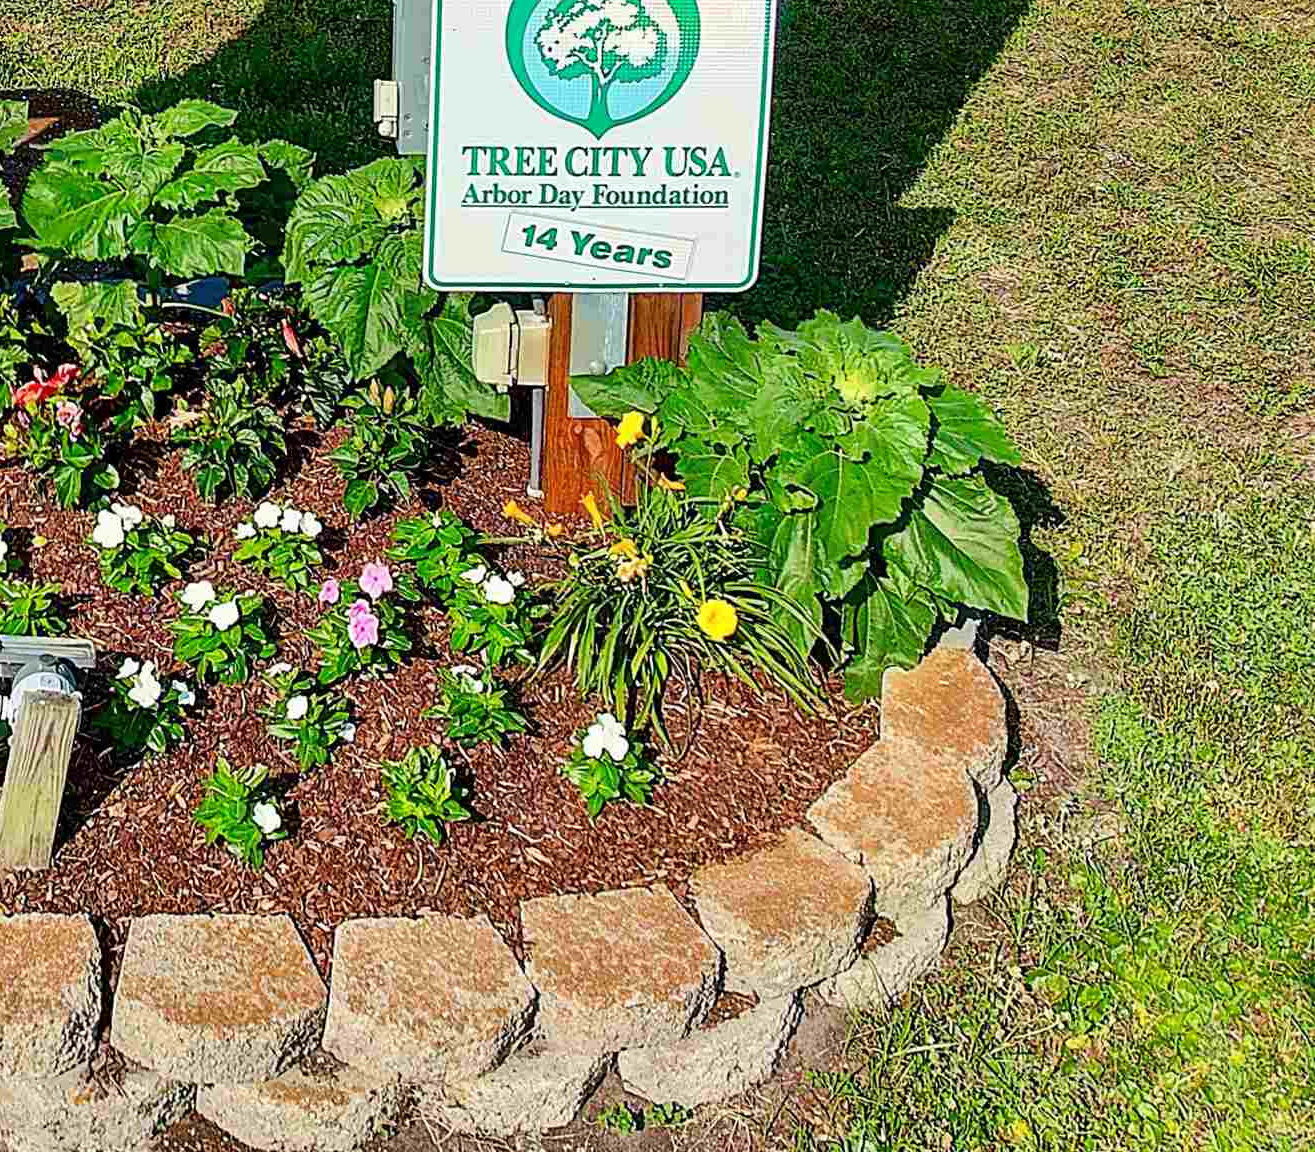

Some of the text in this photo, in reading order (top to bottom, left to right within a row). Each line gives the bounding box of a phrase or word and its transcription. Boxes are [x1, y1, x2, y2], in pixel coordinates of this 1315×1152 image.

[461, 146, 732, 178] TREE CITY USA
[461, 183, 729, 212] Arbor Day Foundation
[521, 224, 673, 269] 14 Years
